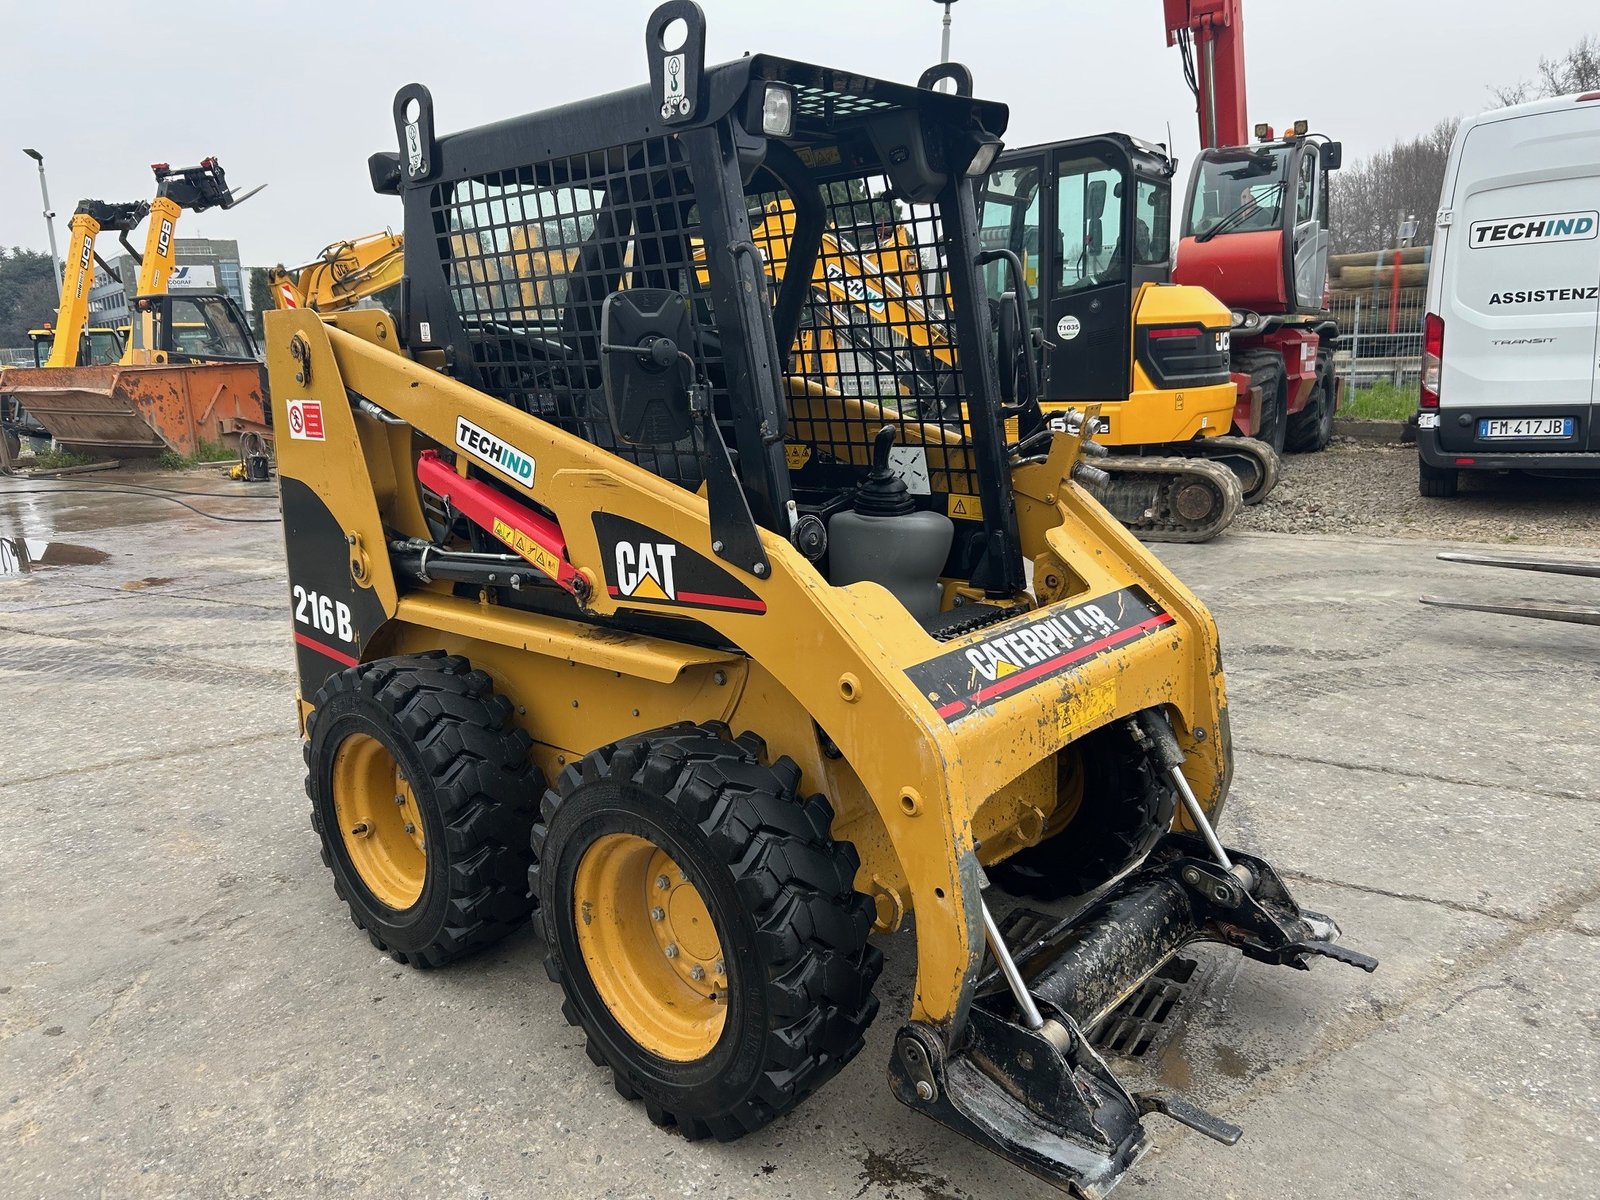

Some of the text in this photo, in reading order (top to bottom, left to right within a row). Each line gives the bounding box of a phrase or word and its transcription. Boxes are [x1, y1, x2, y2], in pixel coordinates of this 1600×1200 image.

[157, 219, 172, 257] JCB
[1476, 218, 1593, 242] TECHIND
[80, 235, 92, 269] JCB
[1488, 287, 1599, 305] ASSISTENZ
[1215, 332, 1230, 351] JC
[1492, 338, 1557, 346] TRANSIT
[460, 423, 532, 479] TECHIND
[615, 540, 677, 601] CAT
